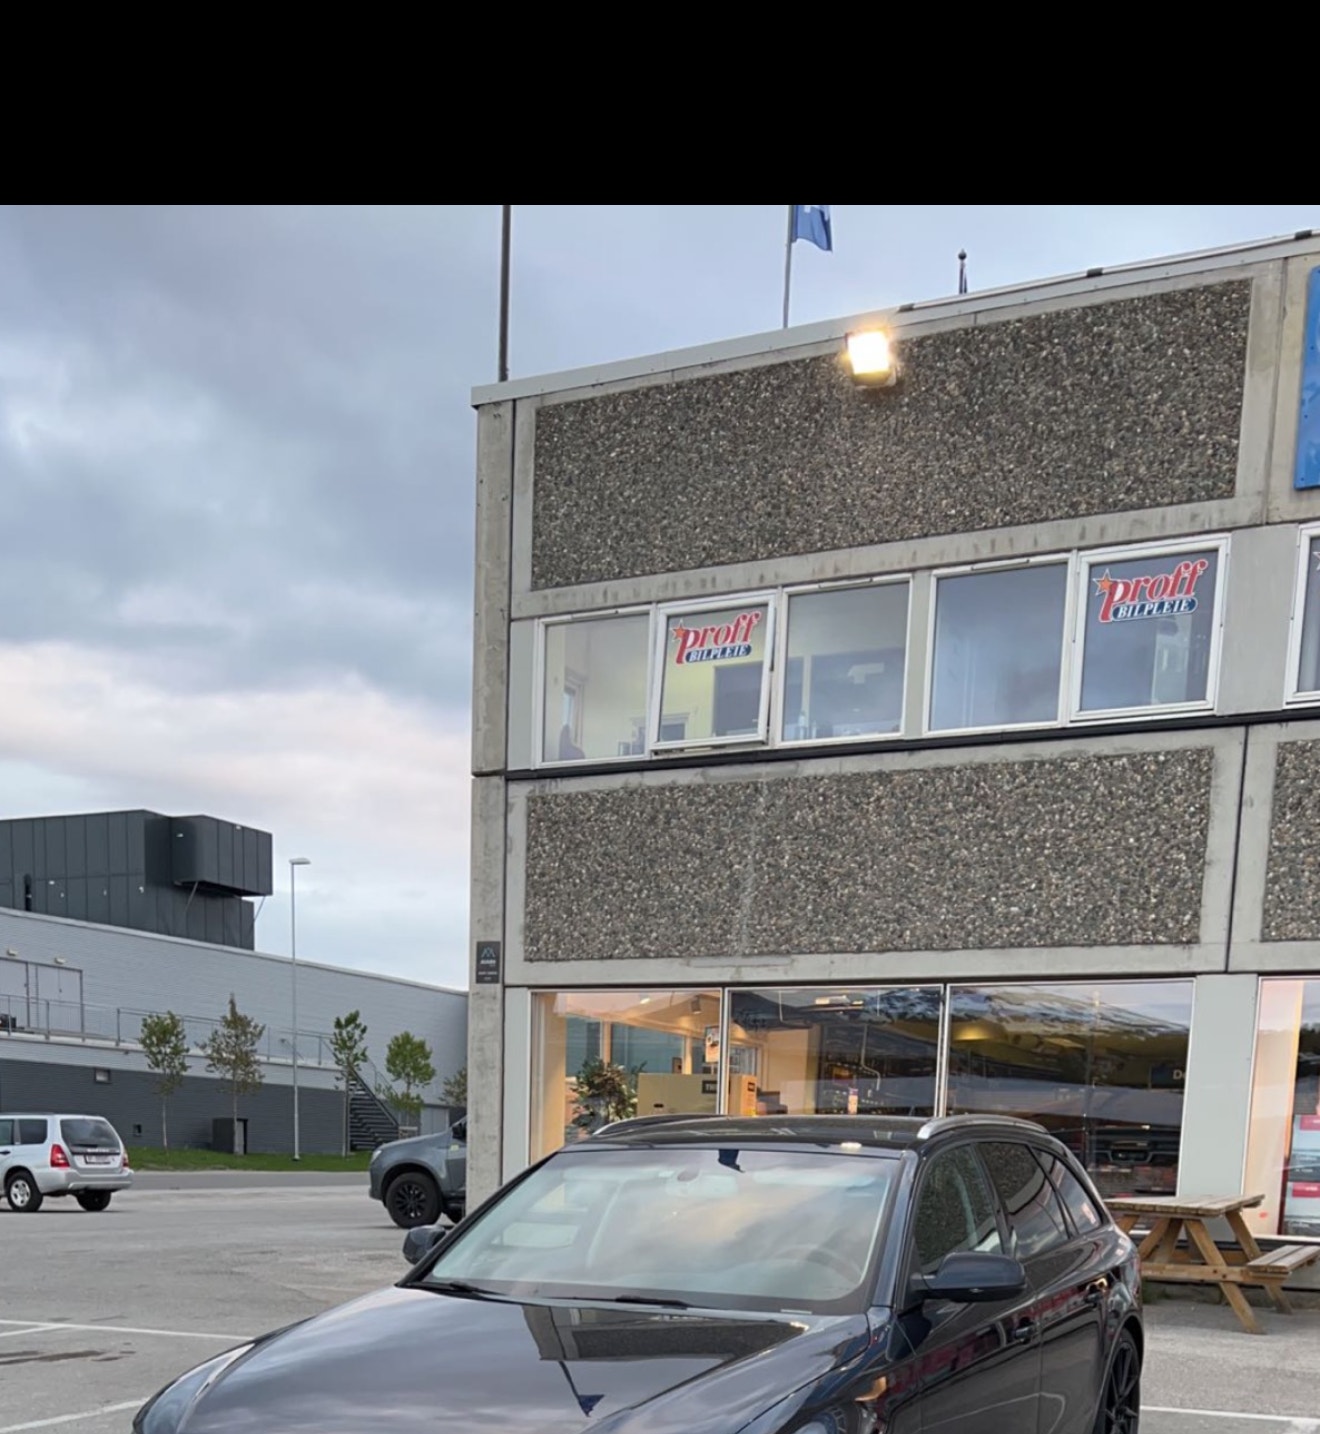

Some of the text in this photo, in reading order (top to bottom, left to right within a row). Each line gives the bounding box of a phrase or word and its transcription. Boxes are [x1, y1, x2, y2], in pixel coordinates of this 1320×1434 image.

[1100, 559, 1208, 622] proff
[1117, 599, 1191, 618] BILPLEIE
[676, 612, 761, 664] proff
[688, 645, 747, 662] BILPLEIE
